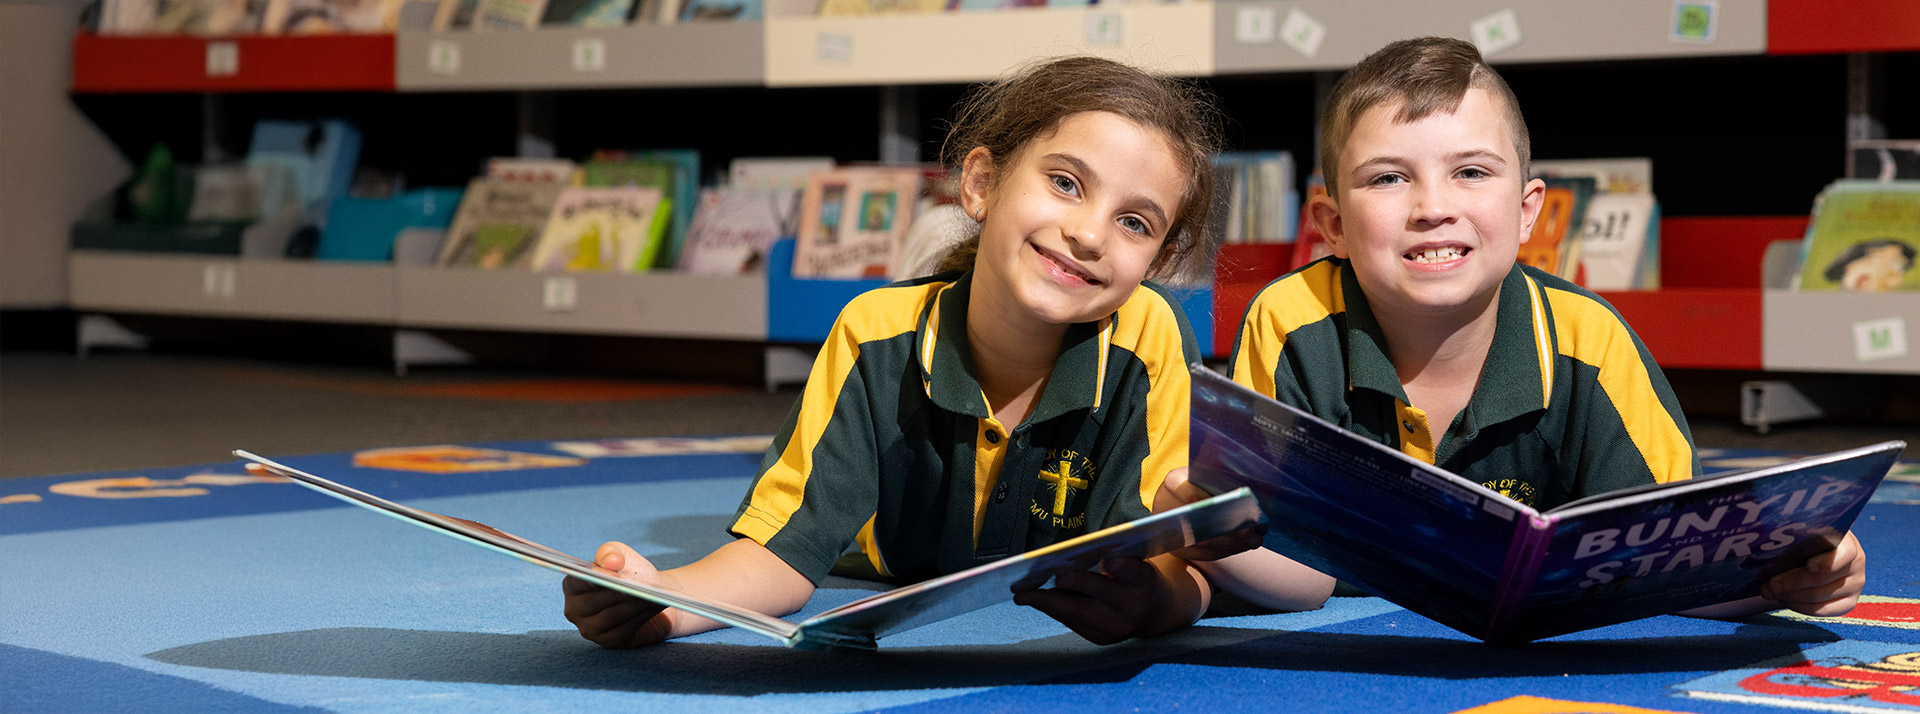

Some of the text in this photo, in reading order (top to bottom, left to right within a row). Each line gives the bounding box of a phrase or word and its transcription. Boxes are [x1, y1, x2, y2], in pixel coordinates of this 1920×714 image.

[1061, 448, 1079, 461] OF
[1499, 478, 1518, 489] OF
[1707, 493, 1745, 506] THE
[1573, 477, 1851, 560] BUNYIP
[1660, 526, 1745, 549] AND THE
[1579, 522, 1807, 588] STARS
